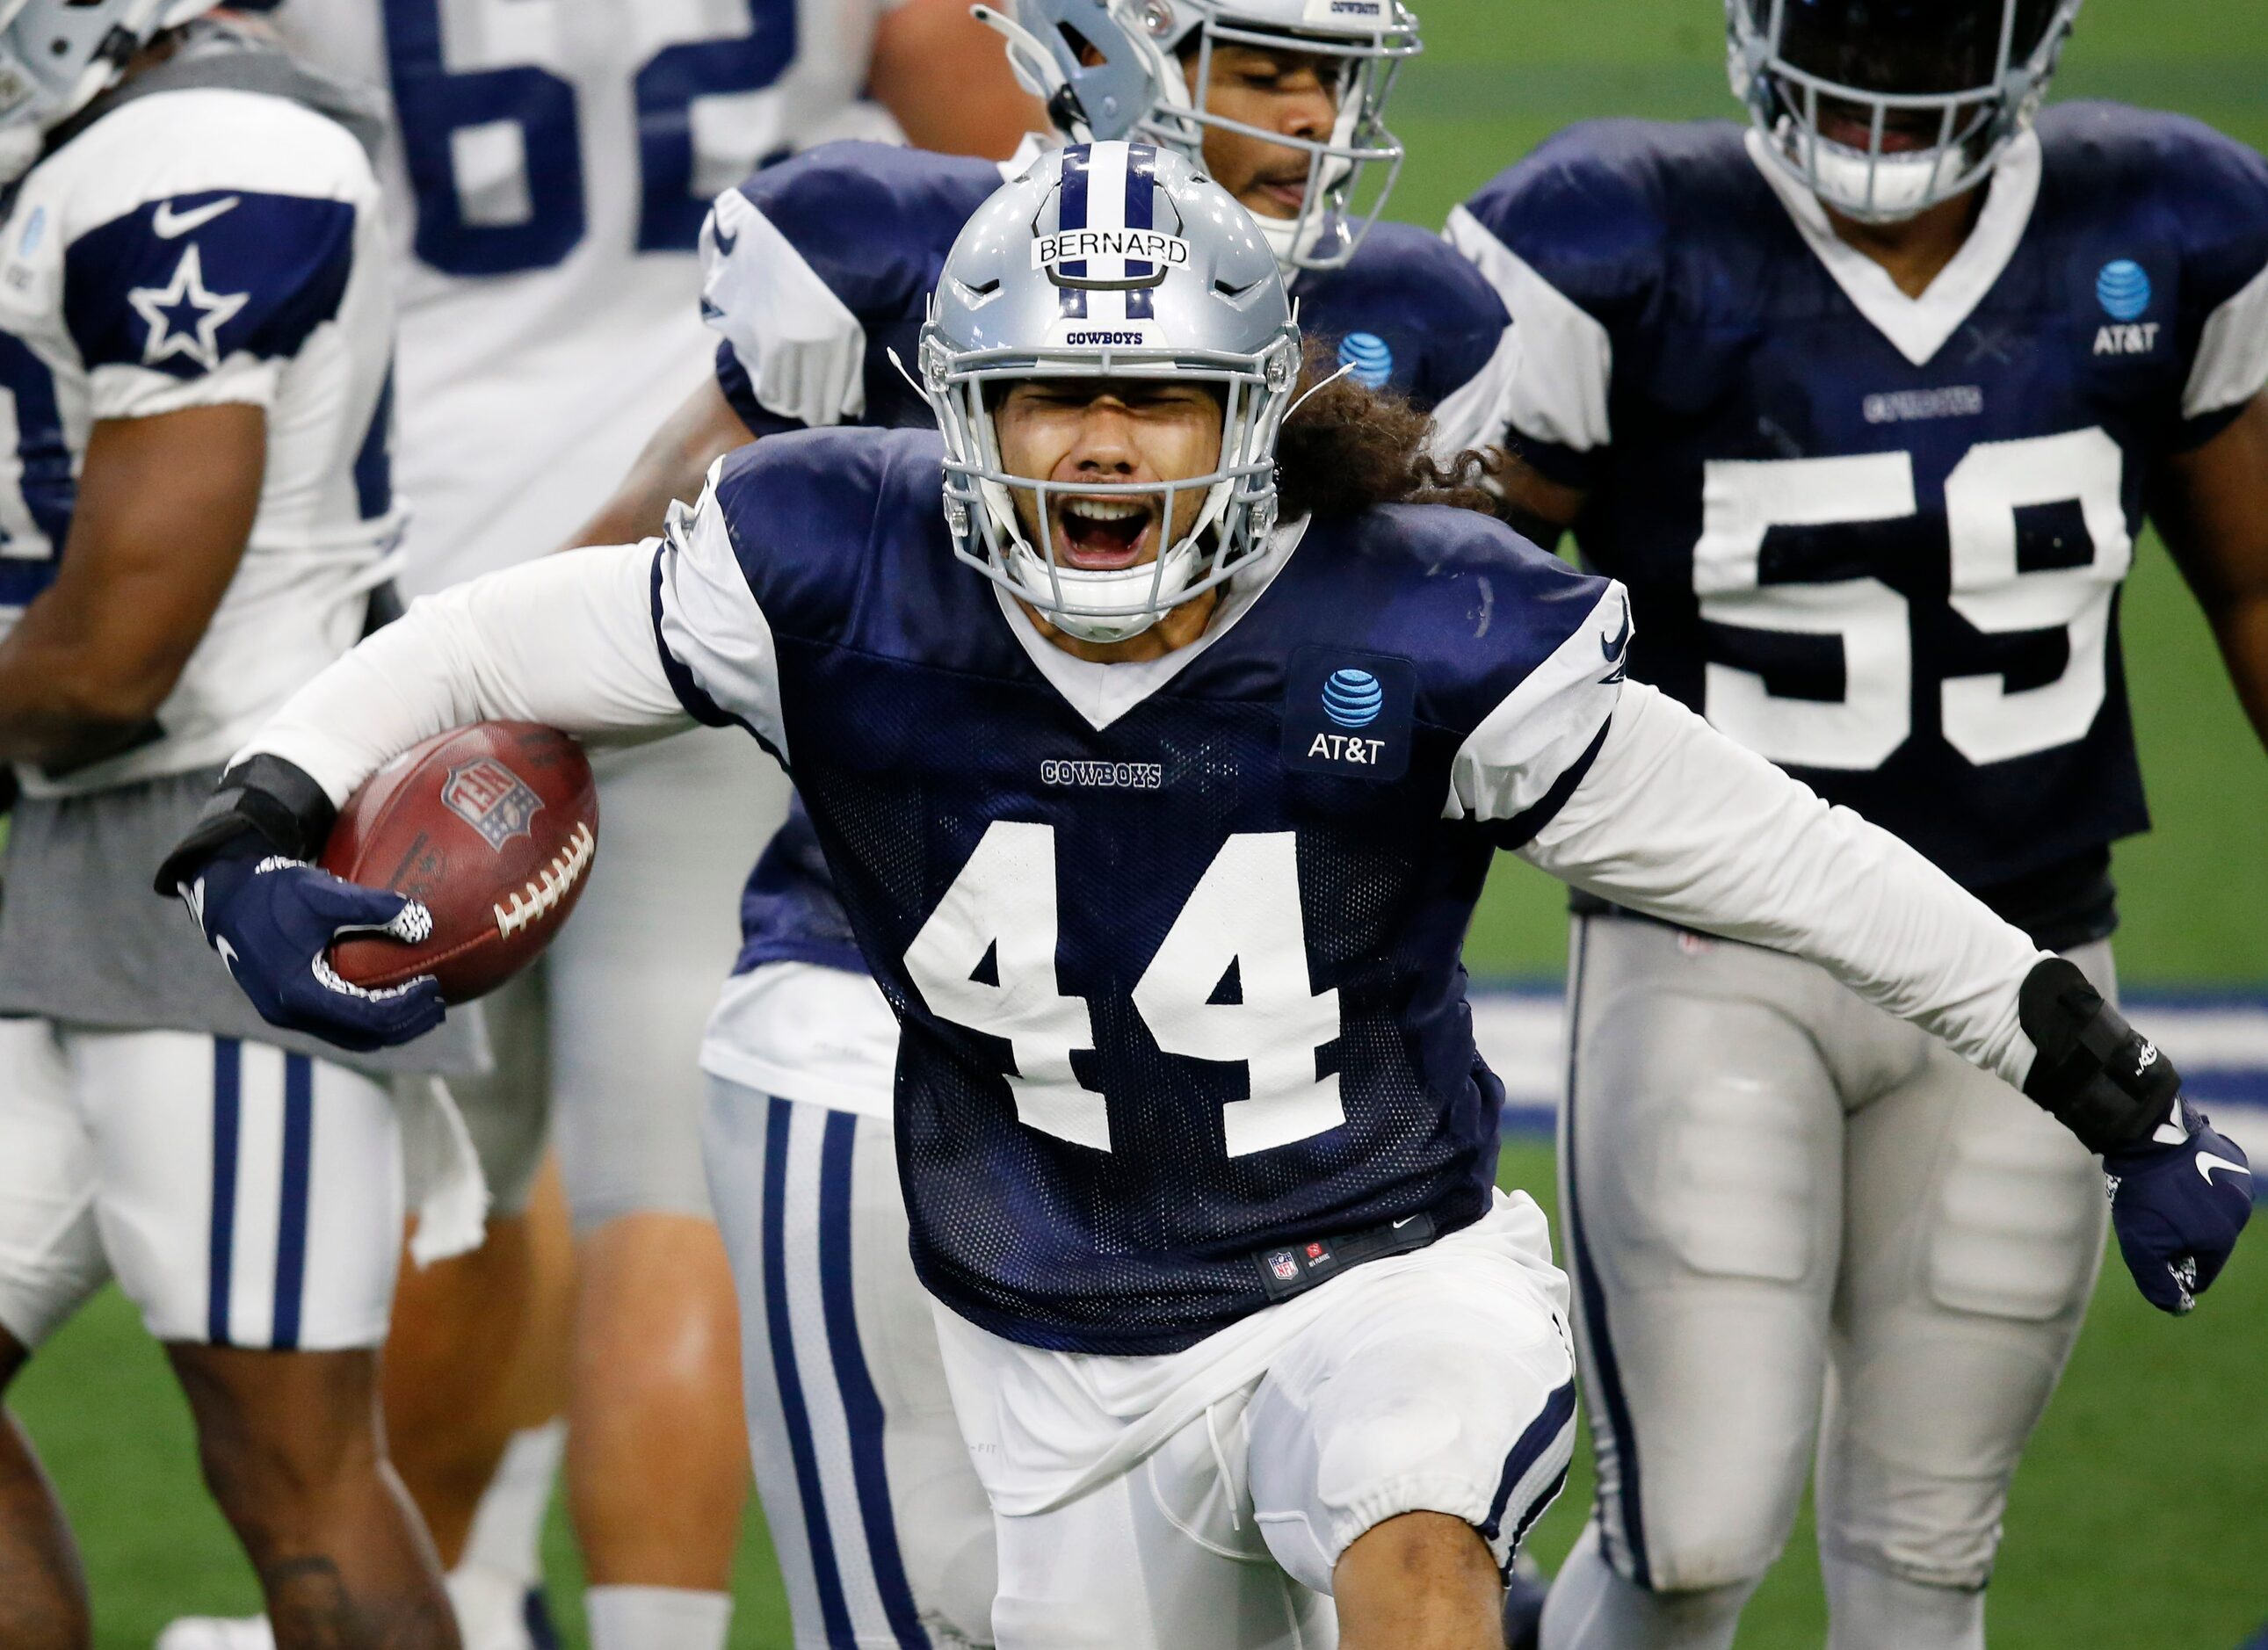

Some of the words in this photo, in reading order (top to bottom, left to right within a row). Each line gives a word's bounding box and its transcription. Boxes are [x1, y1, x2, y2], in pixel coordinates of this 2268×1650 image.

[1040, 232, 1188, 264] BERNARD
[1066, 331, 1143, 345] COWBOYS
[2093, 322, 2160, 355] AT&T
[1692, 425, 2133, 771] 59
[1308, 732, 1386, 765] AT&T
[452, 763, 514, 815] NFL
[1040, 759, 1162, 789] COWBOYS
[902, 820, 1346, 1158] 44
[1274, 1263, 1295, 1277] NFL
[969, 1443, 997, 1454] -FIT
